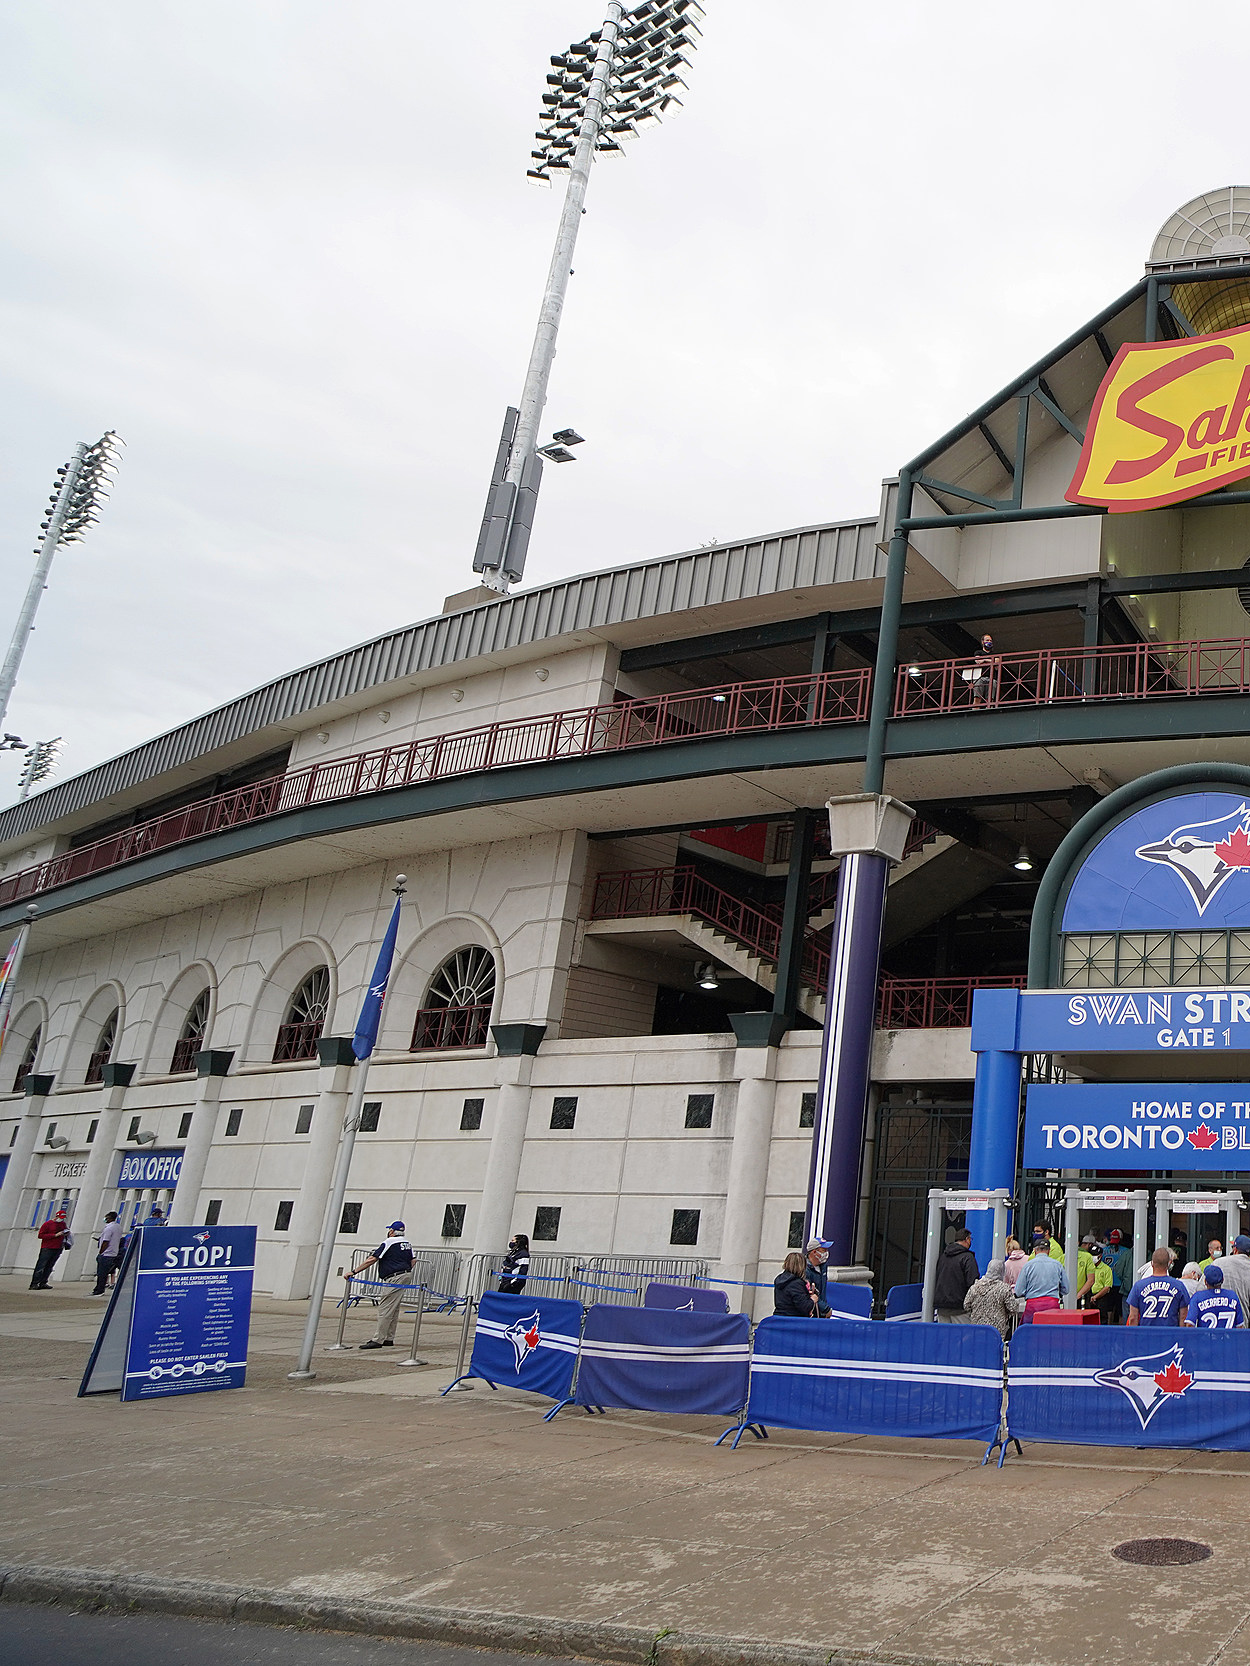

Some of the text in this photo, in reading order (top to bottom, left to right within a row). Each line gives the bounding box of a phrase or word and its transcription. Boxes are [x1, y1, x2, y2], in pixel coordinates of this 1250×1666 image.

[1067, 995, 1173, 1026] SWAN
[1156, 1028, 1232, 1048] GATE 1
[1132, 1102, 1192, 1119] HOME
[1198, 1101, 1226, 1119] OF
[1041, 1124, 1185, 1150] TORONTO
[120, 1156, 183, 1180] BOX OFFIC
[164, 1246, 232, 1268] STOP!
[1140, 1282, 1170, 1298] GUERRERO
[1142, 1296, 1174, 1318] 27
[1198, 1298, 1228, 1312] GUERRERO
[1200, 1312, 1236, 1328] 27
